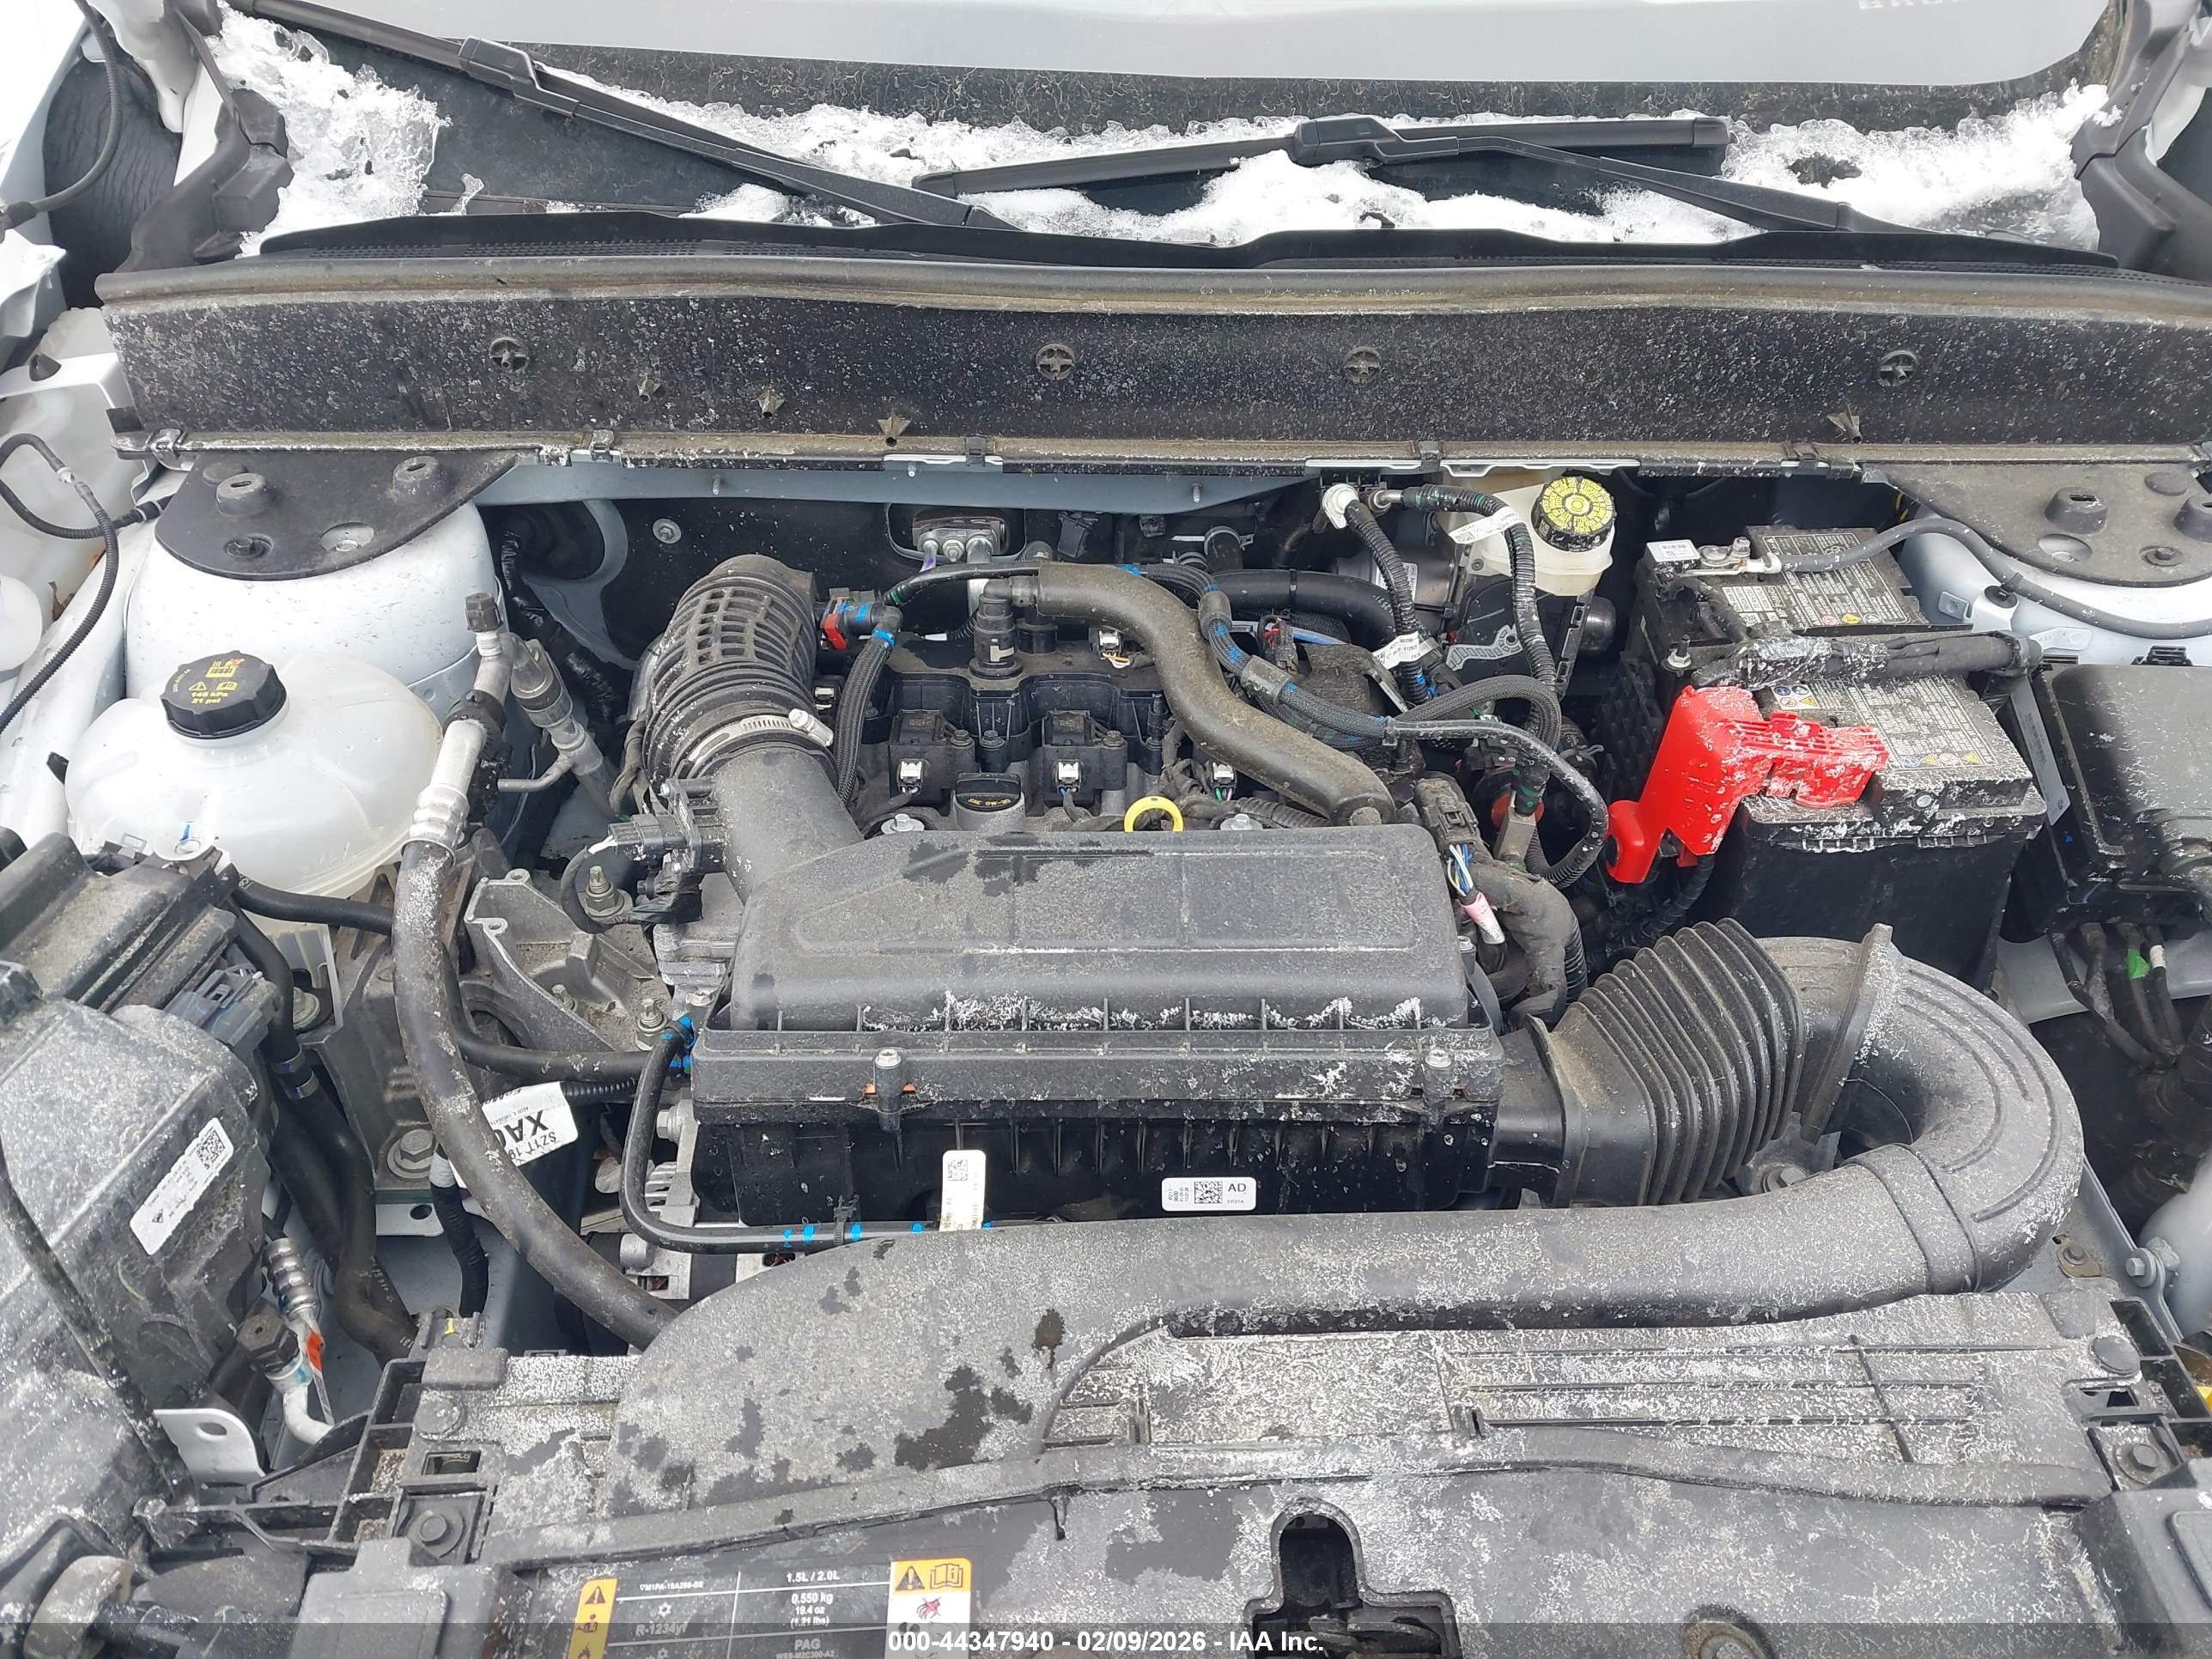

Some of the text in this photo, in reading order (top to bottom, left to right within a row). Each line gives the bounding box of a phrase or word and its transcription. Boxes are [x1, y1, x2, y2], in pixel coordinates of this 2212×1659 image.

[1228, 1182, 1246, 1192] AD
[787, 1572, 808, 1583] 1.5L
[817, 1570, 840, 1582] 2.0L
[791, 1592, 834, 1605] 0.550 kg
[795, 1605, 813, 1615] 19.4
[635, 1621, 687, 1636] R-1234yf
[794, 1638, 821, 1650] PAG
